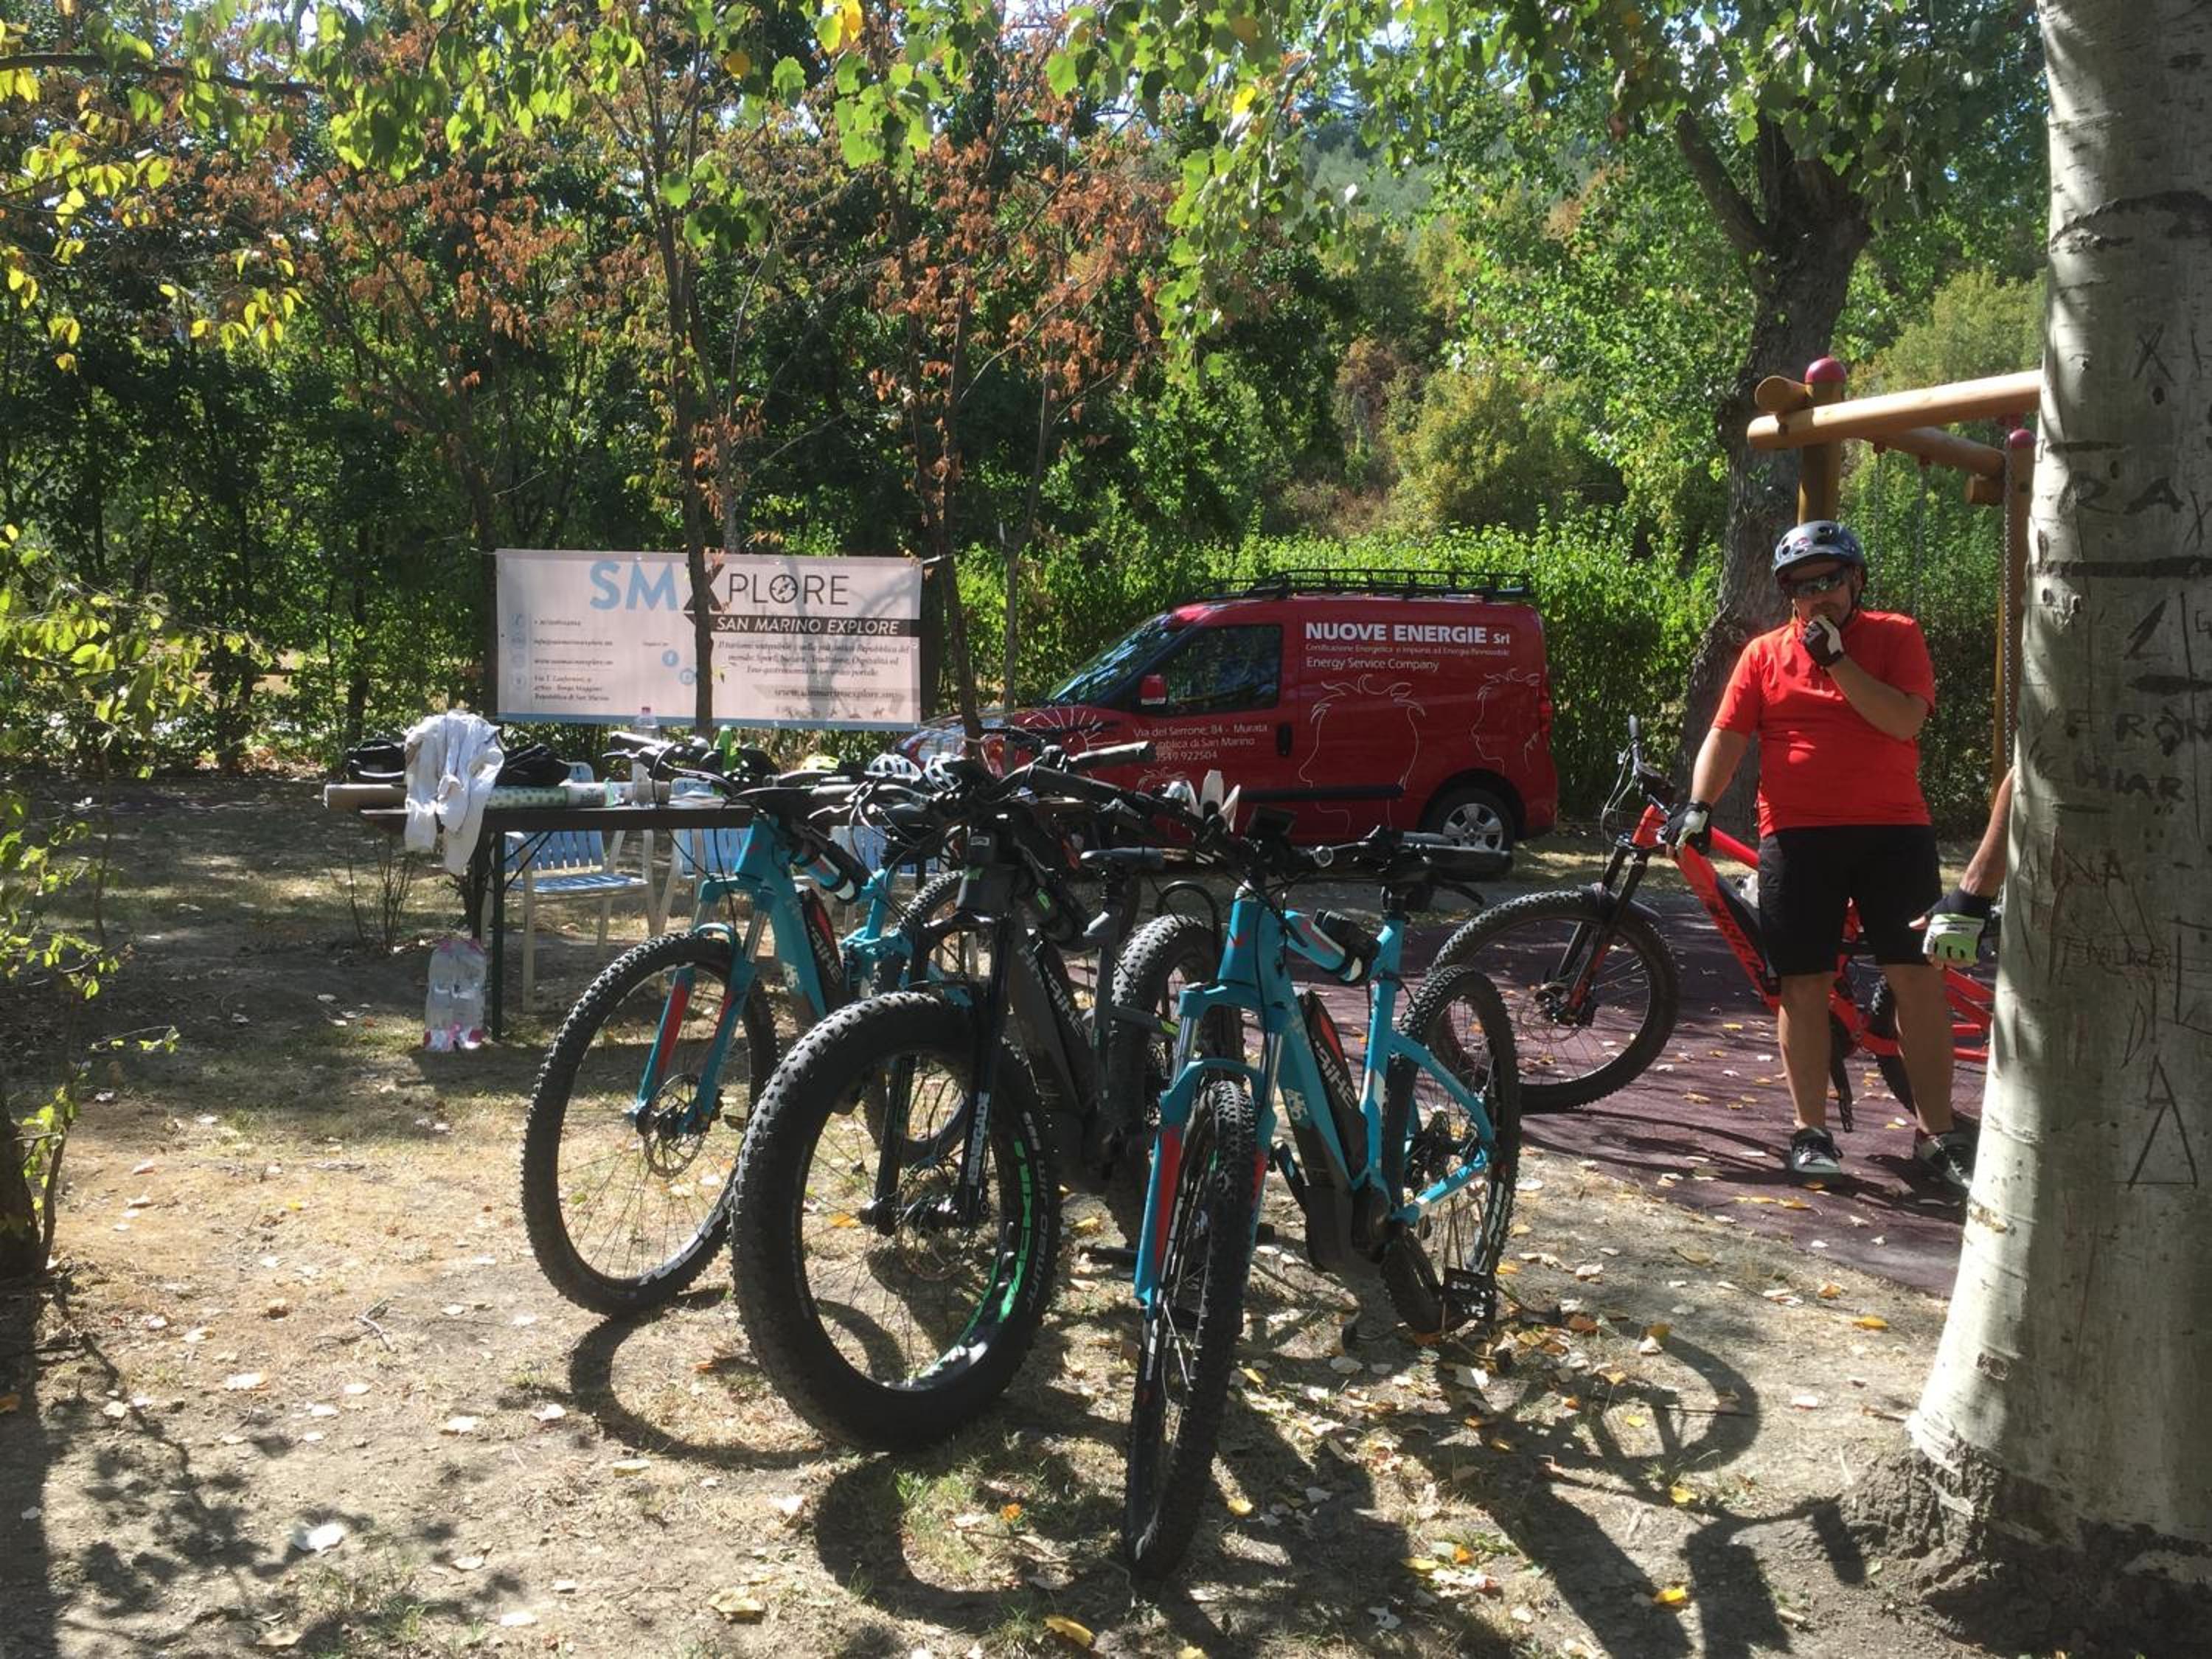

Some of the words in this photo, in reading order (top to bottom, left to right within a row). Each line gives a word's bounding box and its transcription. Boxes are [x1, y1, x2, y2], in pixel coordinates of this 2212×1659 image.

[717, 616, 749, 630] SAN
[754, 618, 821, 633] MARINO
[827, 619, 900, 635] EXPLORE
[1305, 622, 1387, 641] NUOVE
[1394, 625, 1487, 644] ENERGIE
[1492, 633, 1510, 644] Srl
[1306, 656, 1346, 670] Energy
[1347, 657, 1385, 669] Service
[1388, 658, 1439, 672] Company
[1133, 728, 1150, 737] Via
[1151, 727, 1166, 737] del
[1233, 723, 1267, 734] Murata
